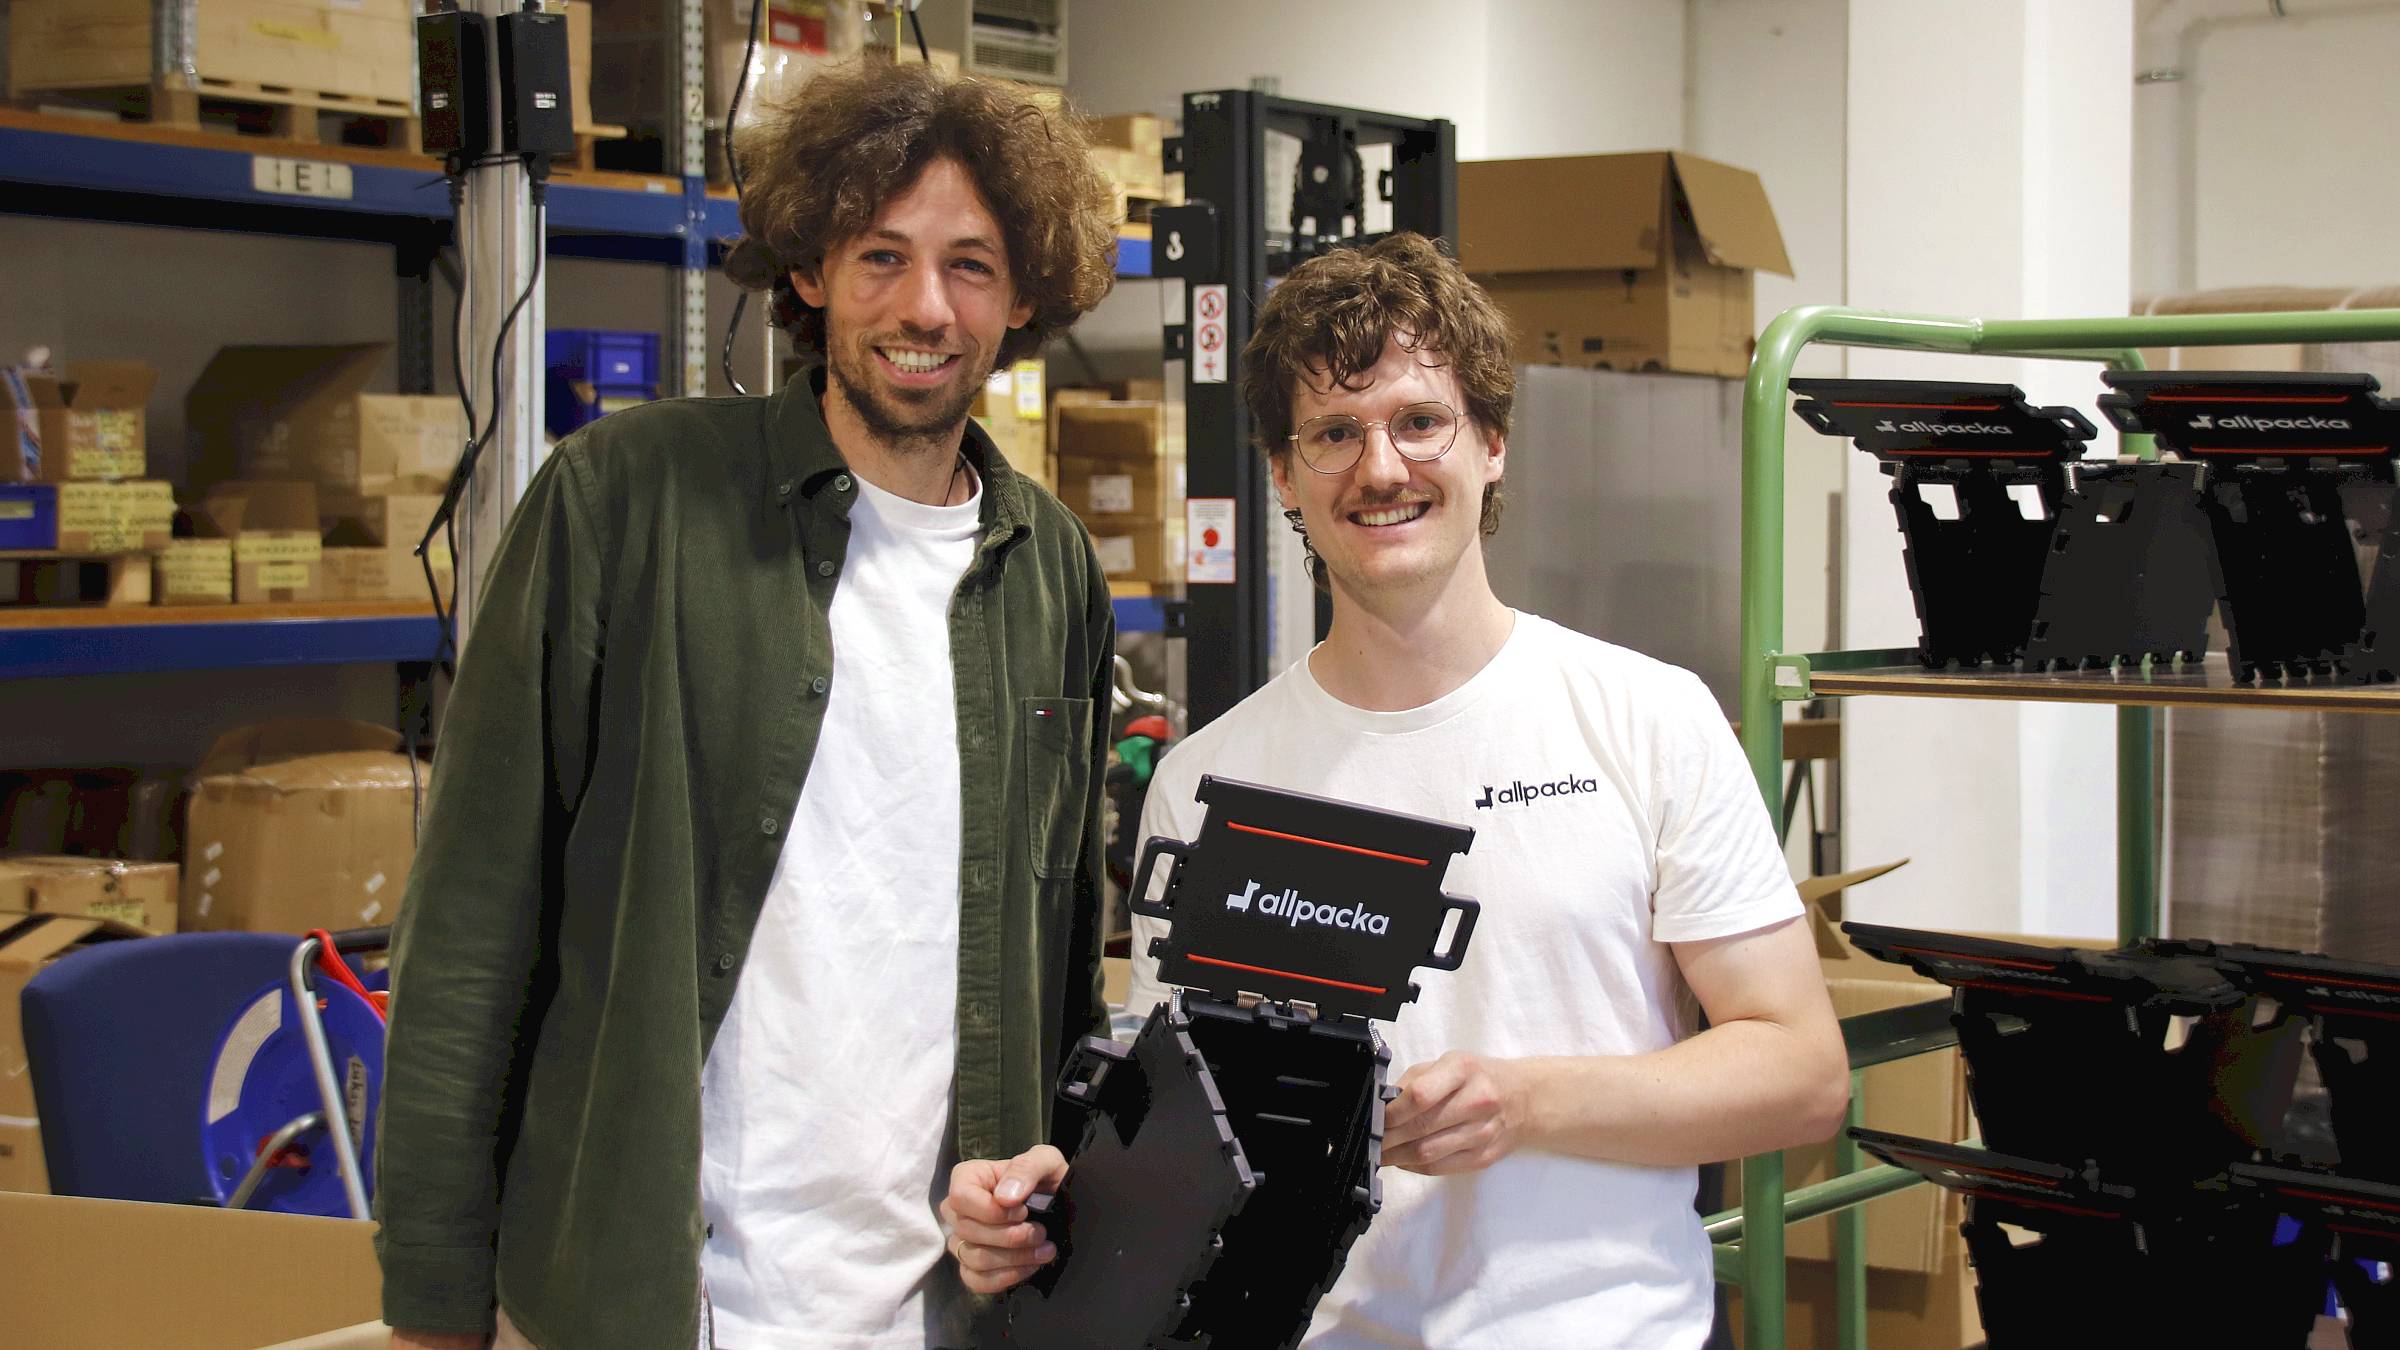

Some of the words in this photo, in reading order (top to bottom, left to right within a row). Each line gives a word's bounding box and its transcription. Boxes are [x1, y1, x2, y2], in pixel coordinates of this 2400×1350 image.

[1900, 421, 2013, 436] allpacka
[2217, 415, 2350, 432] allpacka
[1498, 773, 1597, 806] allpacka
[1258, 888, 1390, 935] allpacka
